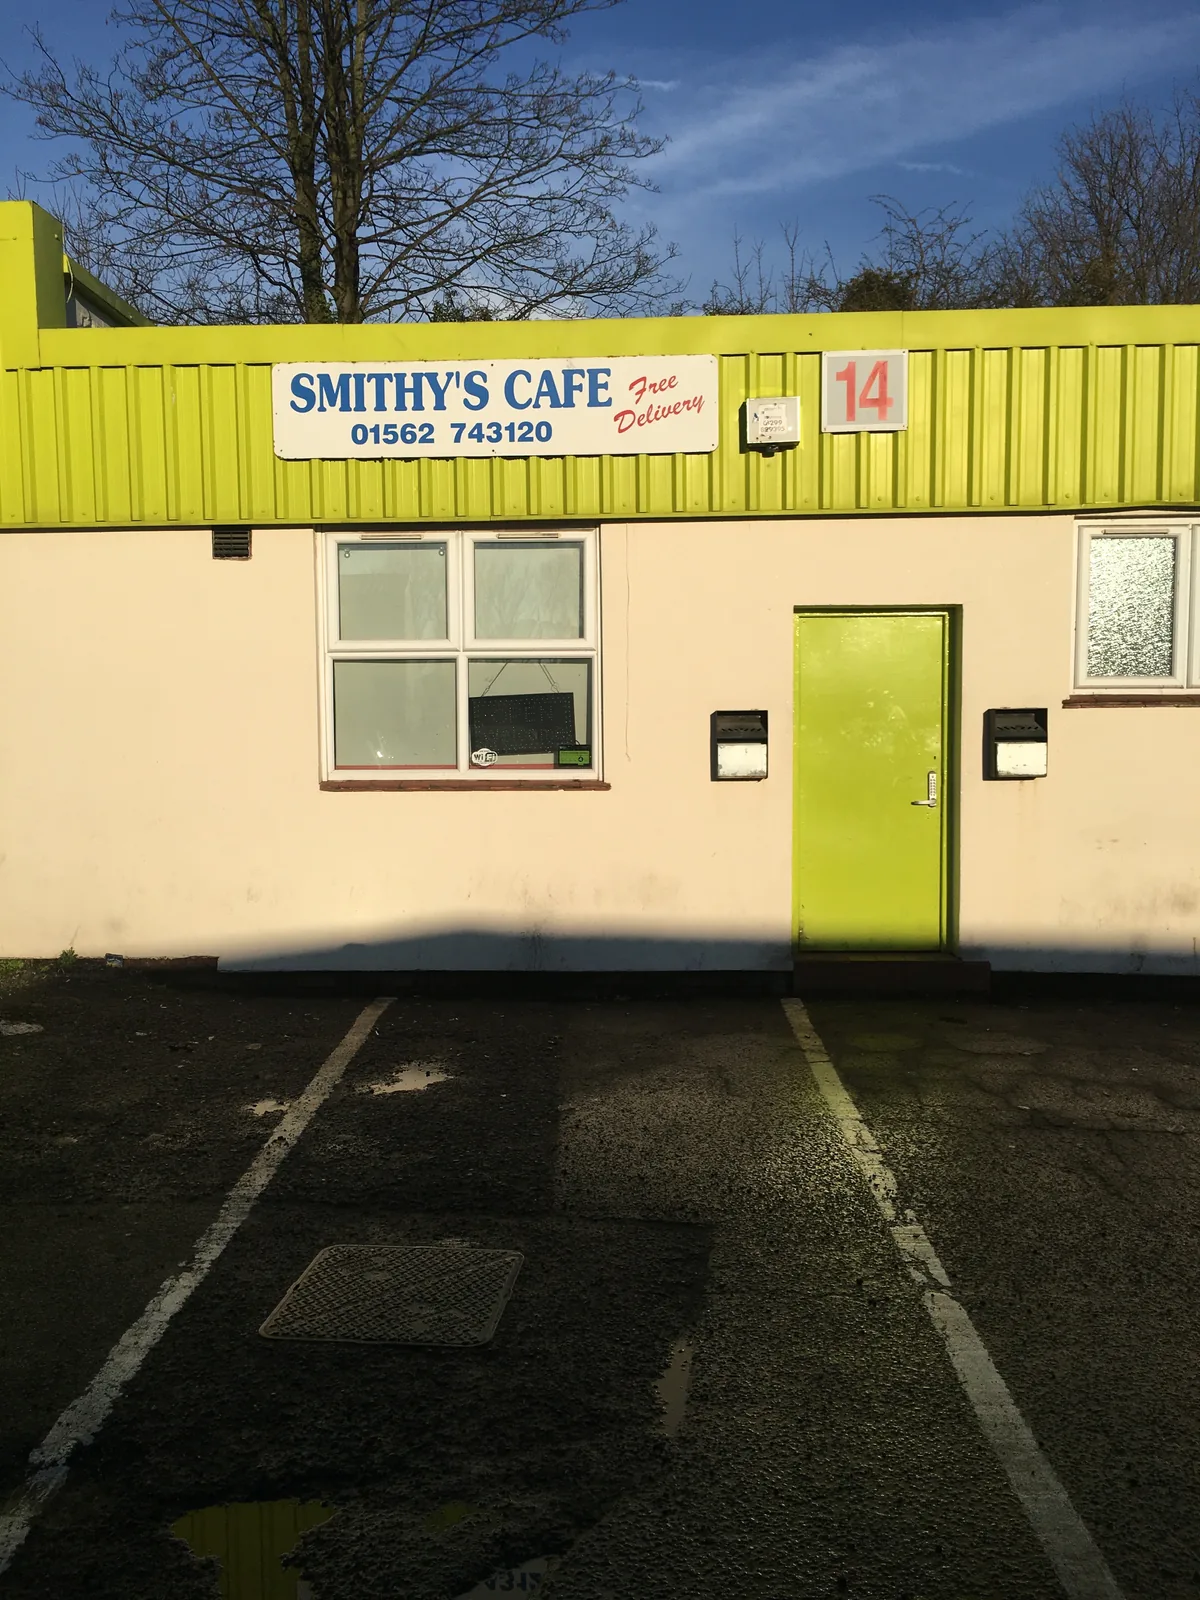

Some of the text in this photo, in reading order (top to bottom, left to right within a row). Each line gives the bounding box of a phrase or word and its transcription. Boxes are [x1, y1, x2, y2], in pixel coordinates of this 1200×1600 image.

[290, 367, 613, 414] SMITHY'S CAFE
[628, 375, 678, 405] Free
[836, 360, 893, 422] 14
[351, 420, 553, 445] 01562 743120
[613, 395, 705, 434] Delivery
